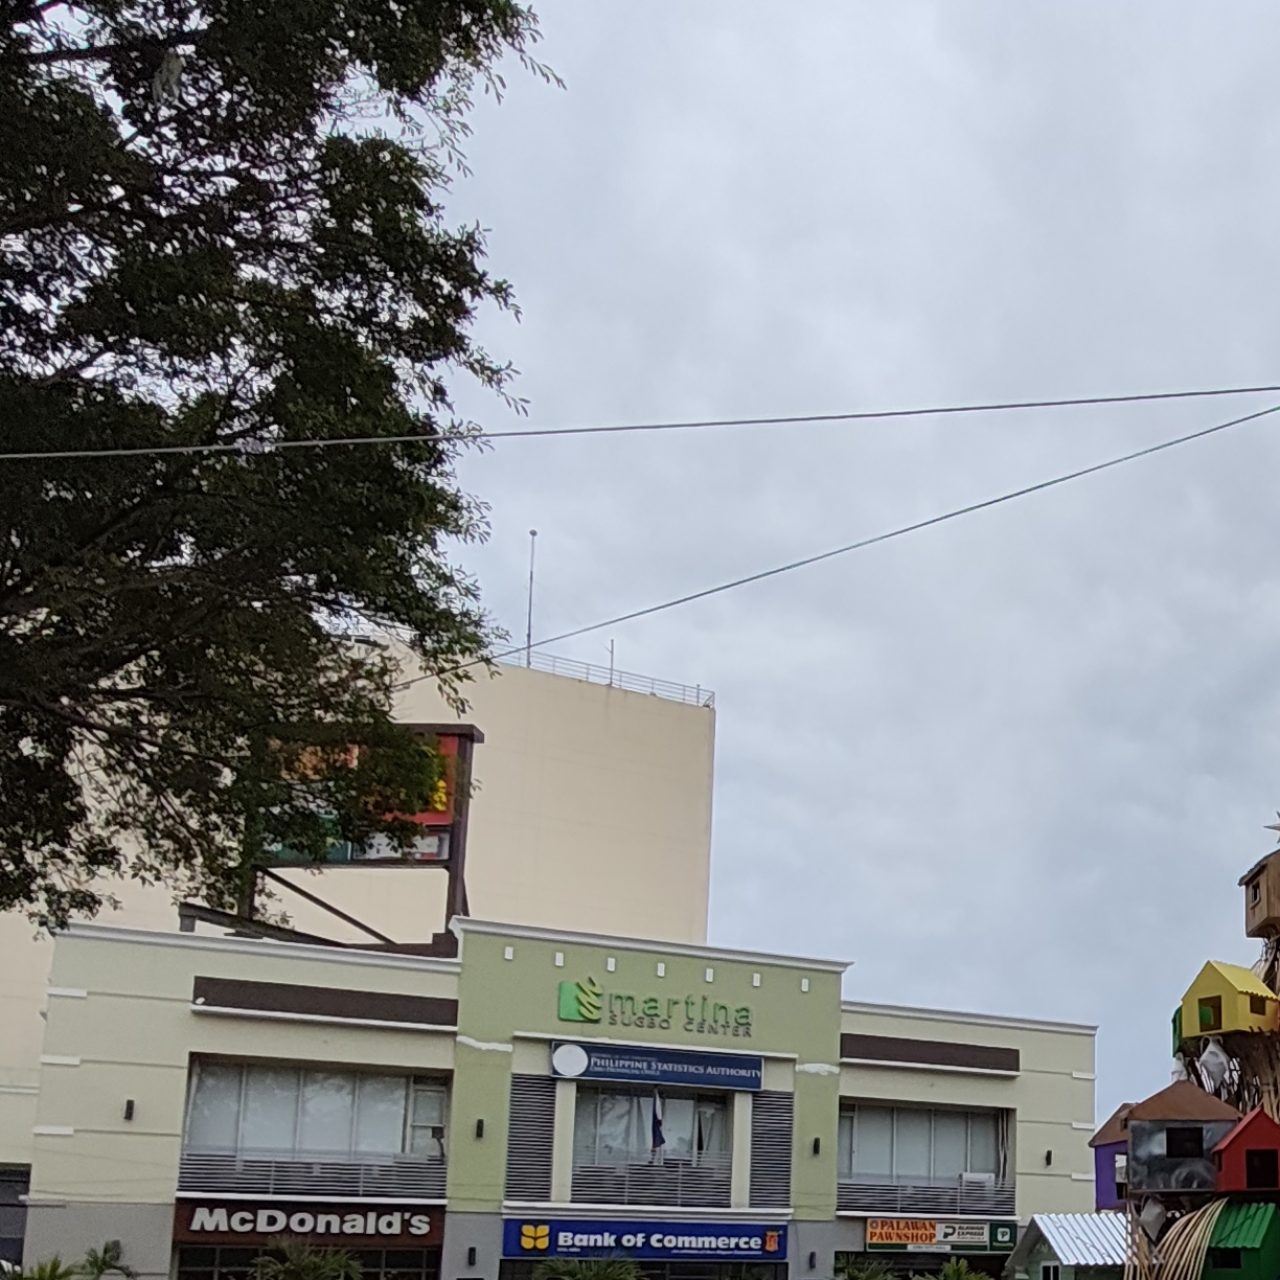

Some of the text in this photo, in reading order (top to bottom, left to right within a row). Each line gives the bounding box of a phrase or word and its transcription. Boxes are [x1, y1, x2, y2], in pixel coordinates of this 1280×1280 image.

[608, 992, 753, 1027] martina
[608, 1013, 753, 1038] SUGBO CENTER
[590, 1057, 649, 1070] PHILIPPINE
[651, 1061, 704, 1074] STATISTICS
[705, 1065, 761, 1078] AUTHORITY
[190, 1207, 431, 1235] McDonald's
[880, 1220, 936, 1231] PALAWAN
[557, 1231, 617, 1247] Bank
[621, 1232, 646, 1247] of
[650, 1232, 762, 1250] Commerce
[869, 1231, 936, 1242] PAWNSHOP
